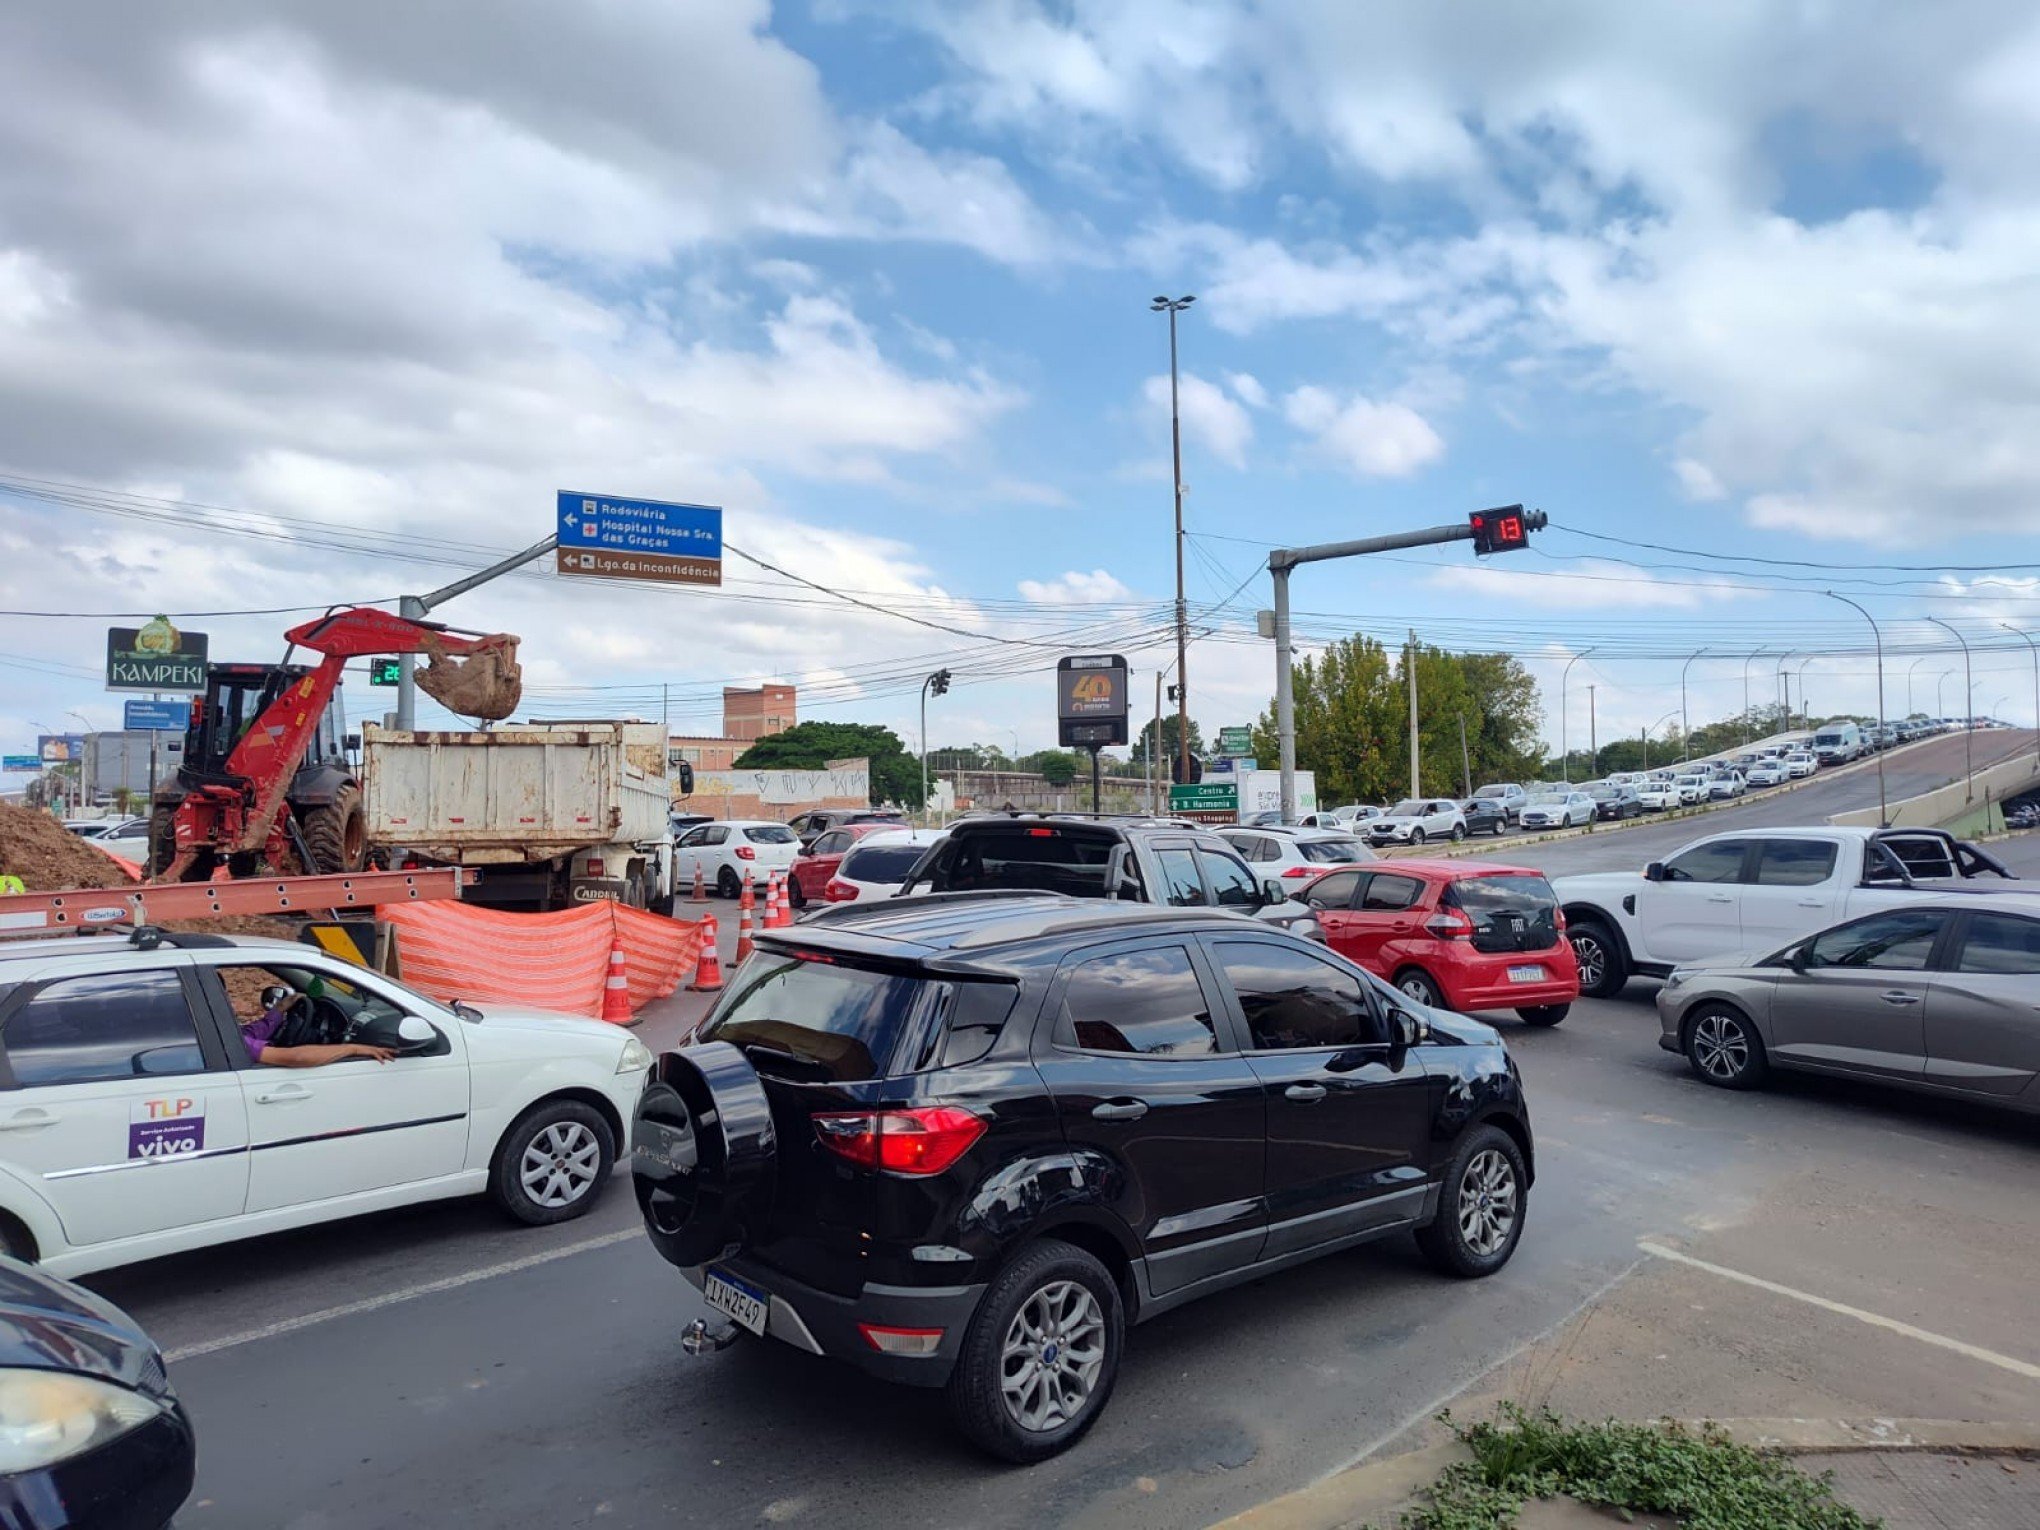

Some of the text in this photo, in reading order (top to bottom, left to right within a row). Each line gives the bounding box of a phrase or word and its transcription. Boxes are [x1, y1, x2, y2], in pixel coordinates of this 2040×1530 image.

[602, 504, 666, 520] Rodoviária
[602, 519, 652, 534] Hospital
[656, 524, 690, 537] Nossa
[602, 532, 669, 547] das Graças
[622, 560, 636, 571] da
[639, 561, 719, 577] Inconfidência
[112, 662, 203, 684] KAMPEKI
[1071, 675, 1112, 703] 40
[144, 1098, 193, 1119] TLP
[138, 1135, 196, 1157] vivo
